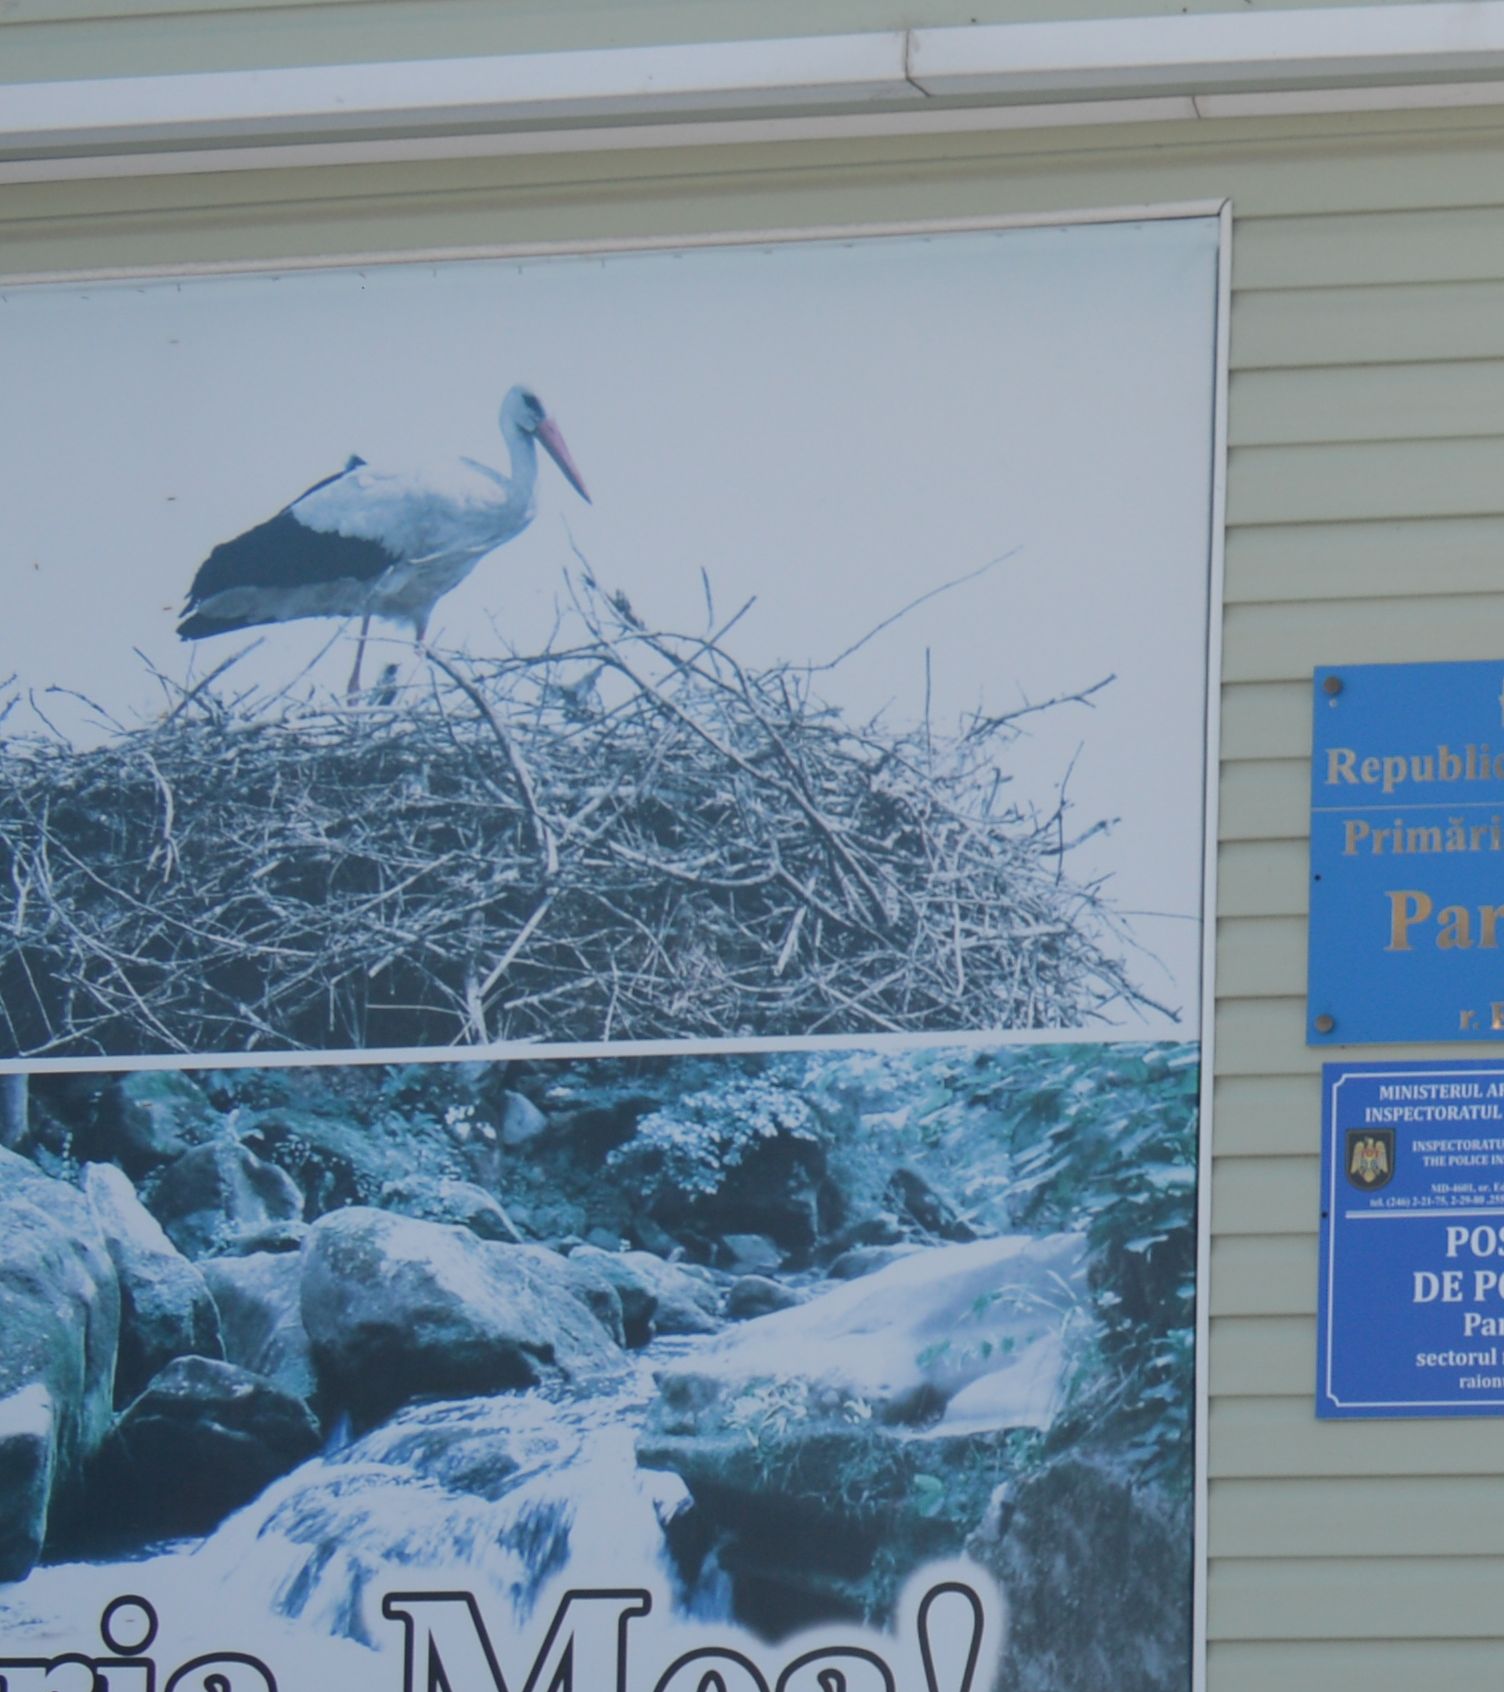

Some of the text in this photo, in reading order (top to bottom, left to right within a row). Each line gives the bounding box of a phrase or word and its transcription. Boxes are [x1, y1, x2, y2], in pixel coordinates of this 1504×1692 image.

[1459, 1007, 1480, 1030] r.
[1379, 1084, 1482, 1100] MINISTERUL
[1365, 1105, 1502, 1122] INSPECTORATUL
[1423, 1156, 1446, 1168] THE
[1448, 1155, 1489, 1166] POLICE
[1413, 1271, 1463, 1303] DE
[1415, 1347, 1497, 1367] sectorul
